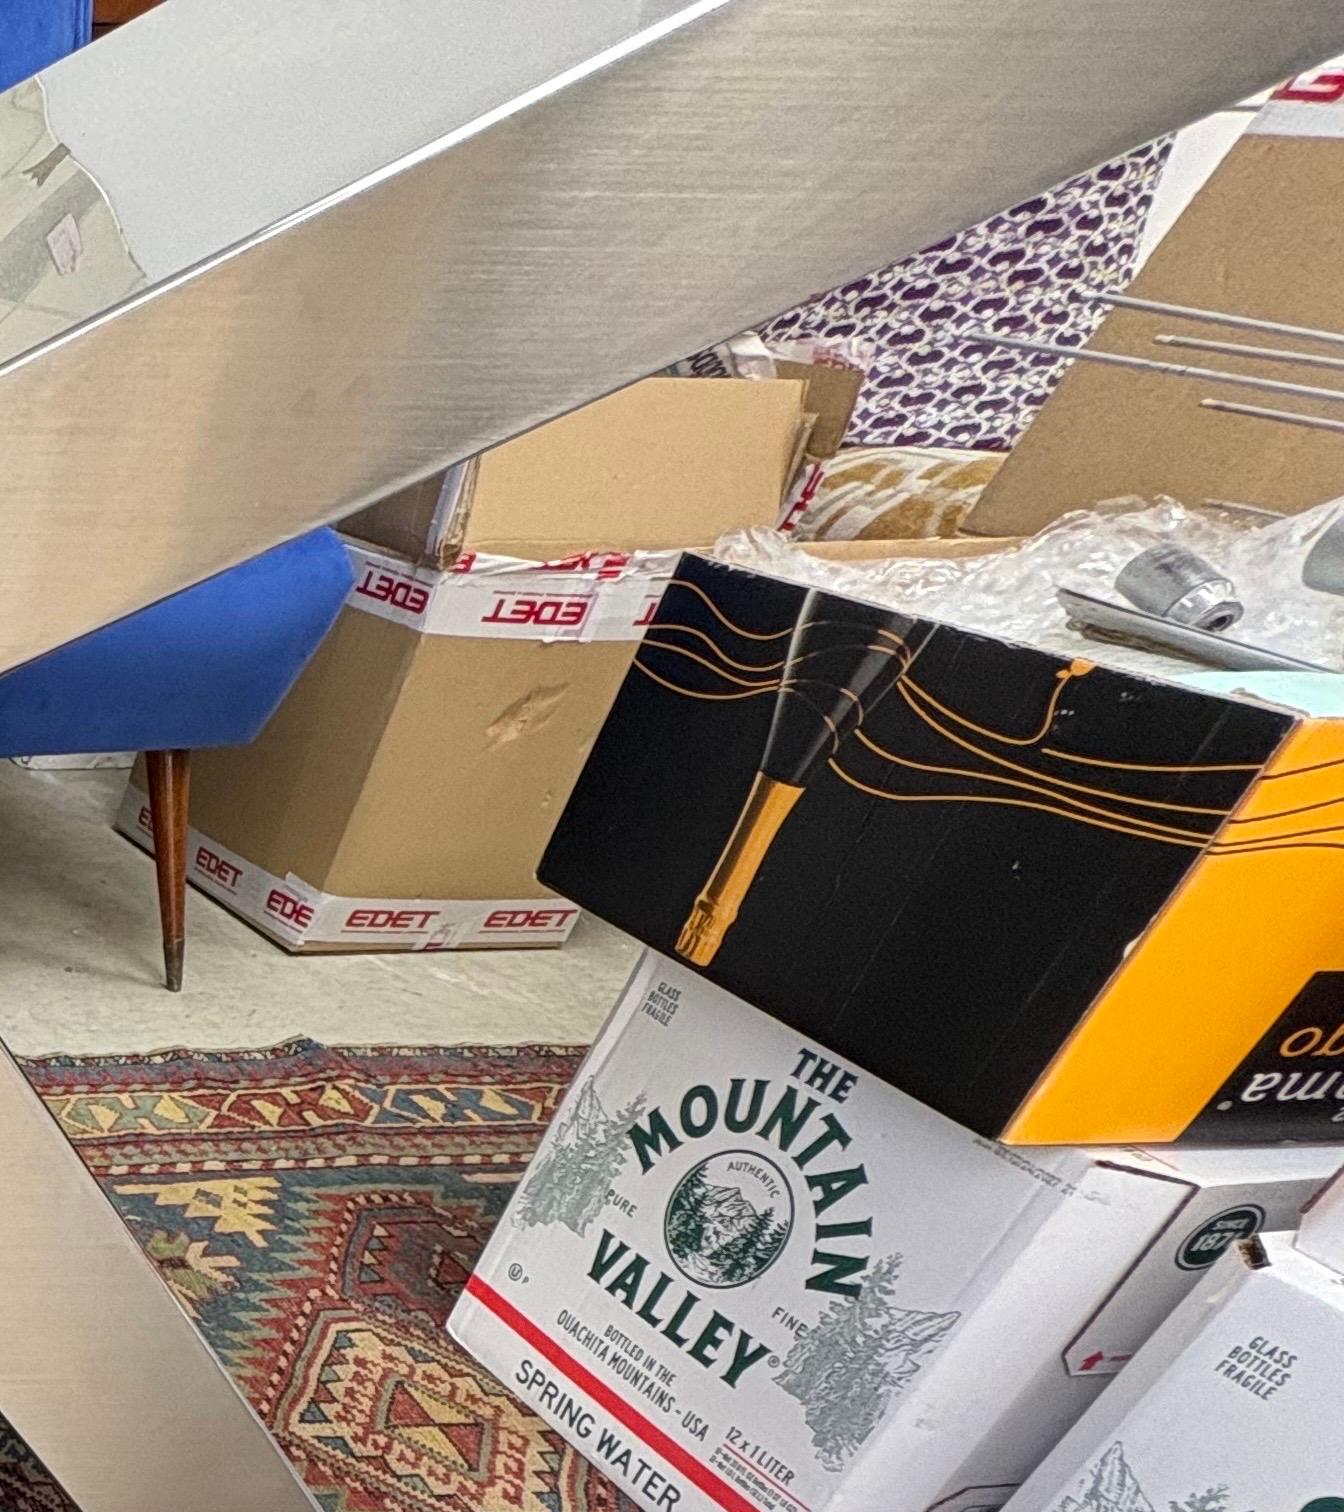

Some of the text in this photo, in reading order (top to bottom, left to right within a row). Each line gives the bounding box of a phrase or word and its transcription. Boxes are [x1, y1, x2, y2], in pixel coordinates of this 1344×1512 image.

[195, 846, 243, 888] EDET
[345, 911, 441, 929] EDET
[483, 909, 578, 929] EDET
[790, 1048, 859, 1104] THE
[626, 1078, 874, 1300] MOUNTAIN
[726, 1160, 781, 1200] AUTHENTIC
[607, 1188, 810, 1338] PURE FINE
[556, 1309, 609, 1364] OUACHITA
[608, 1353, 676, 1414] MOUNTAINS
[681, 1409, 710, 1443] USA
[603, 1324, 677, 1387] BOTTLED IN THE
[1214, 1359, 1279, 1401] FRAGILE
[1227, 1345, 1292, 1388] BOTTLES
[1247, 1335, 1298, 1369] GLASS
[515, 1359, 596, 1440] SPRING
[725, 1426, 742, 1445] 12
[756, 1451, 795, 1487] LITER
